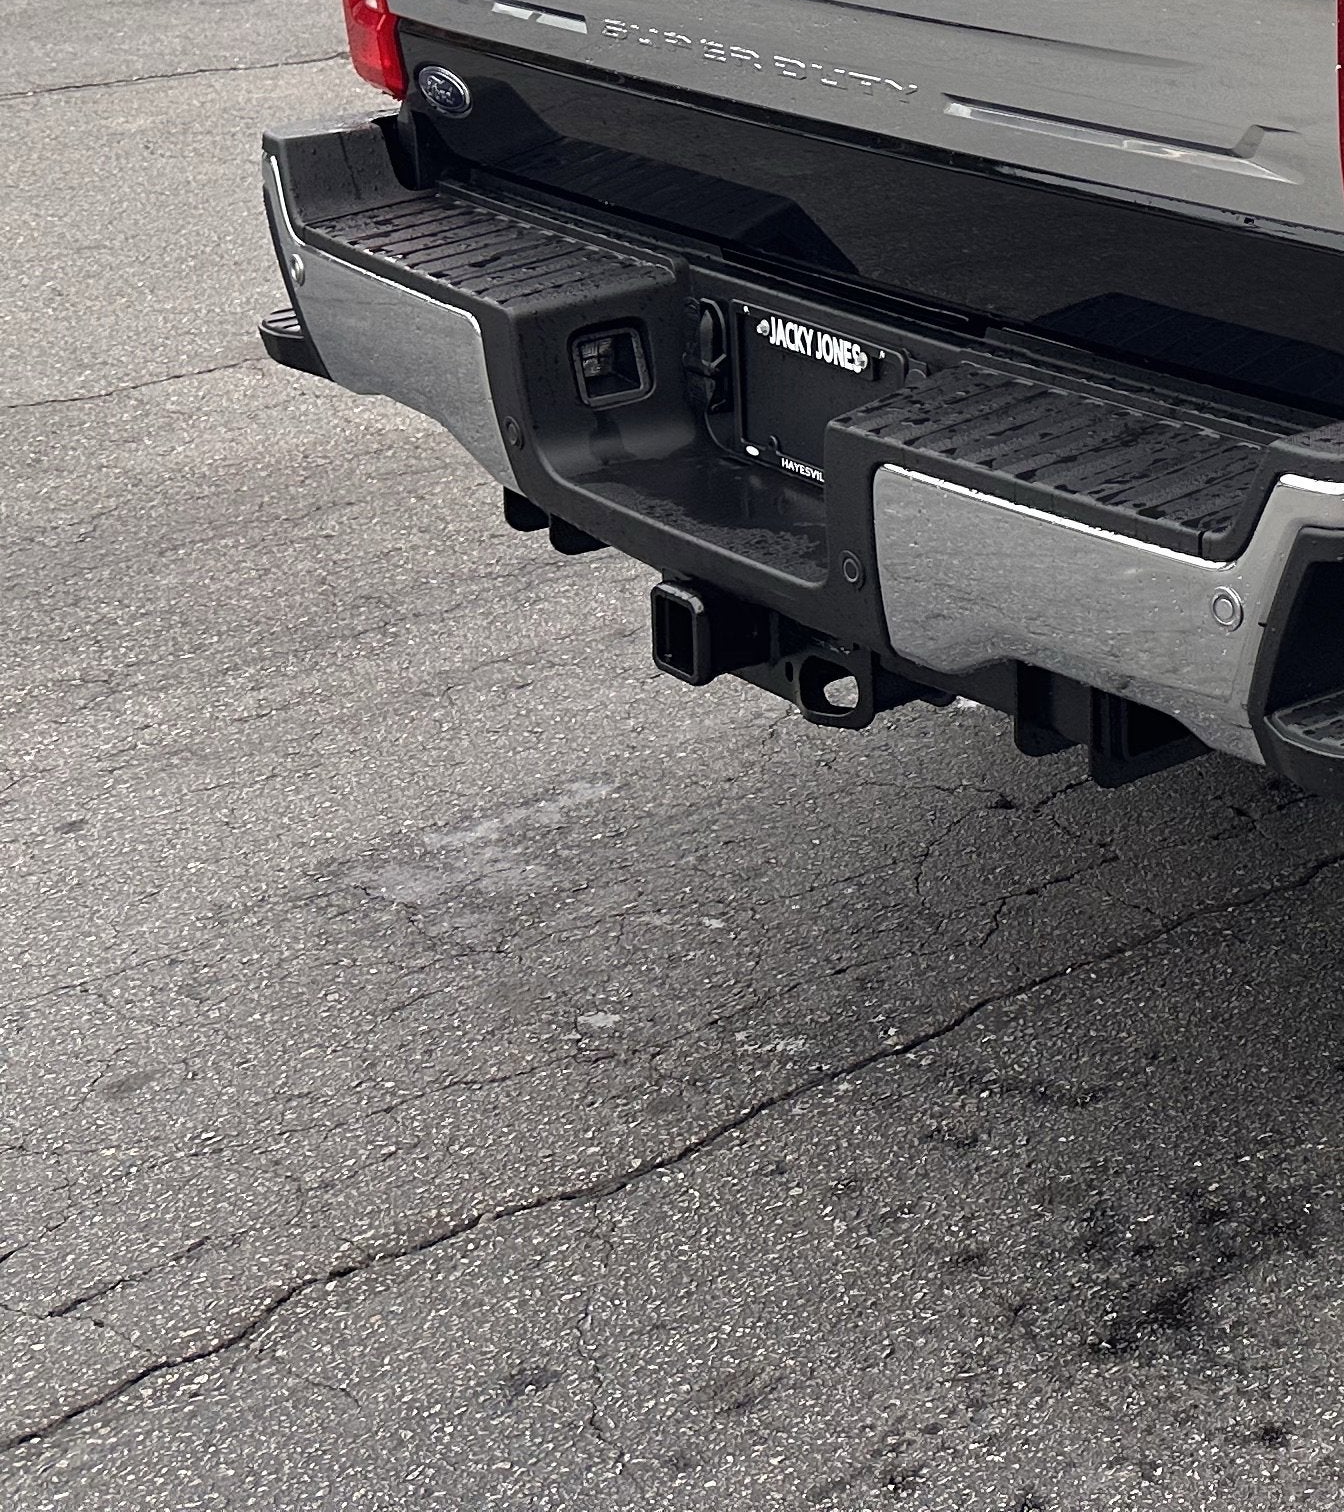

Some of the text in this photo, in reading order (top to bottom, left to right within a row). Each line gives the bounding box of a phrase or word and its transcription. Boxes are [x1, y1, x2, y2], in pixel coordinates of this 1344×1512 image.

[602, 18, 919, 104] SUPER DUTY
[769, 316, 864, 374] JACKY JONES
